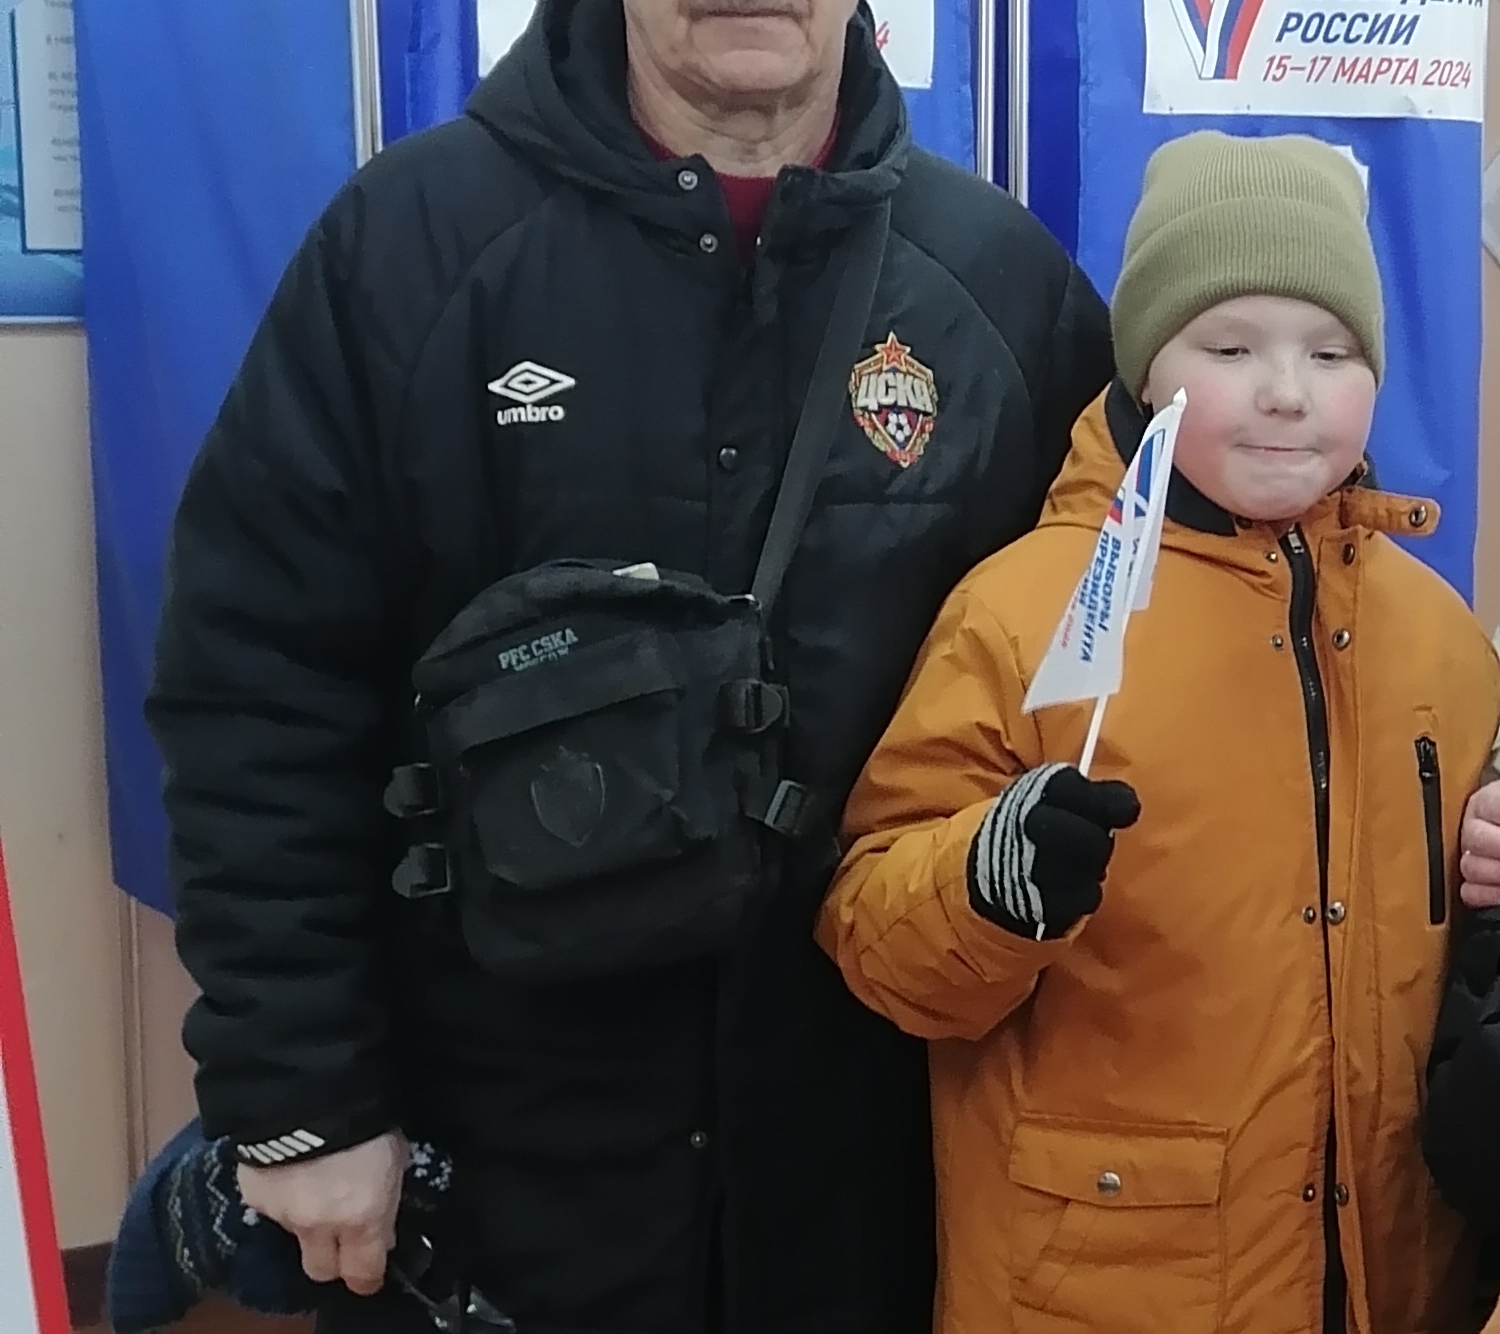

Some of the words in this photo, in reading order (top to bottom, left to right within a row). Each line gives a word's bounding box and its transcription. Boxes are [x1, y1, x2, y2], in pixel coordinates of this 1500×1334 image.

[1276, 11, 1419, 46] РОССИИ
[1333, 56, 1418, 87] МАРТА
[1423, 59, 1472, 89] 2024
[857, 371, 934, 413] ЦСКА
[497, 404, 565, 425] umbro
[1079, 531, 1110, 664] ПРЕЗИДЕНТА
[1098, 535, 1122, 633] ВЫБОРЫ
[498, 641, 531, 671] PFC
[531, 627, 579, 658] CSKA
